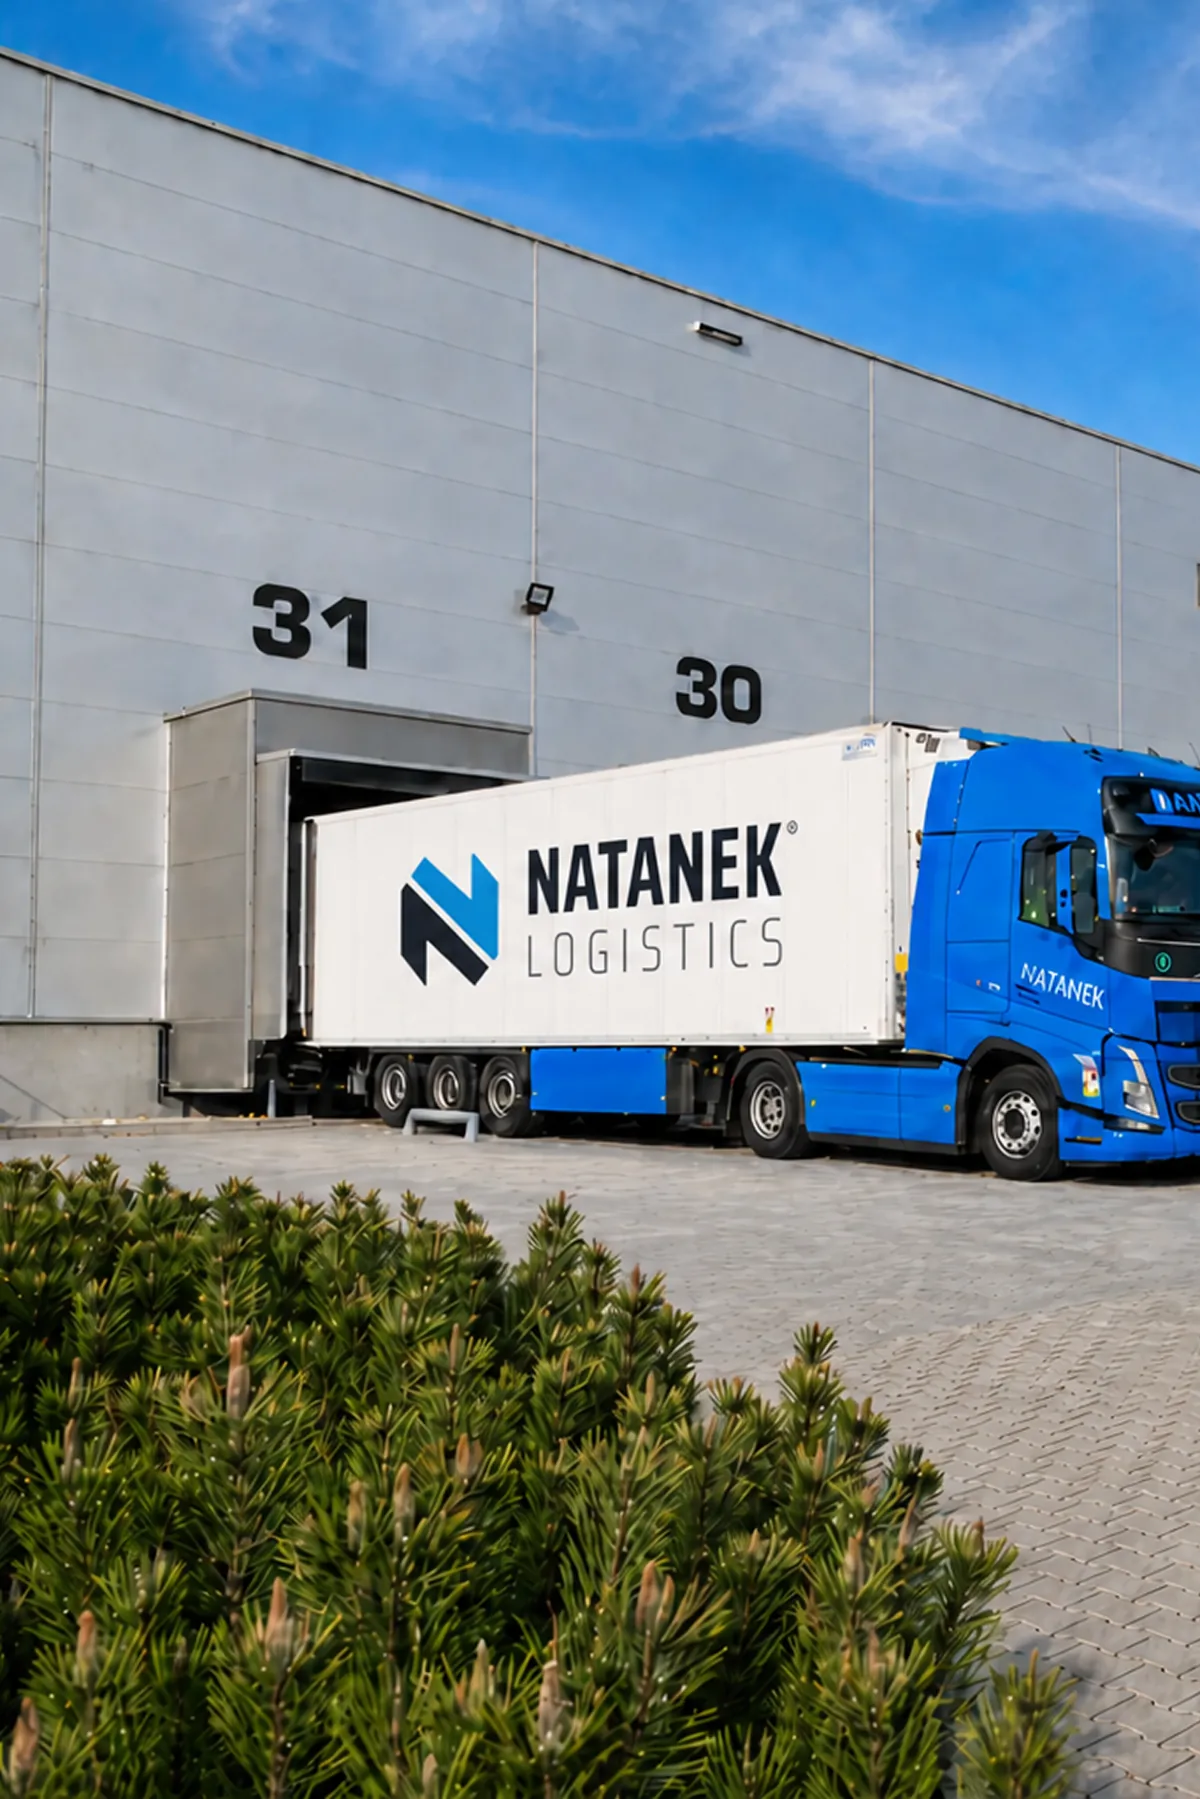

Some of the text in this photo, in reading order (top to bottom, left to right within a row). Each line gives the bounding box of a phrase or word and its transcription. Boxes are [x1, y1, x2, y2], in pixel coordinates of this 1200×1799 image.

[253, 584, 368, 669] 31
[676, 657, 761, 724] 30
[528, 917, 783, 977] LOGISTICS
[1021, 963, 1104, 1010] NATANEK
